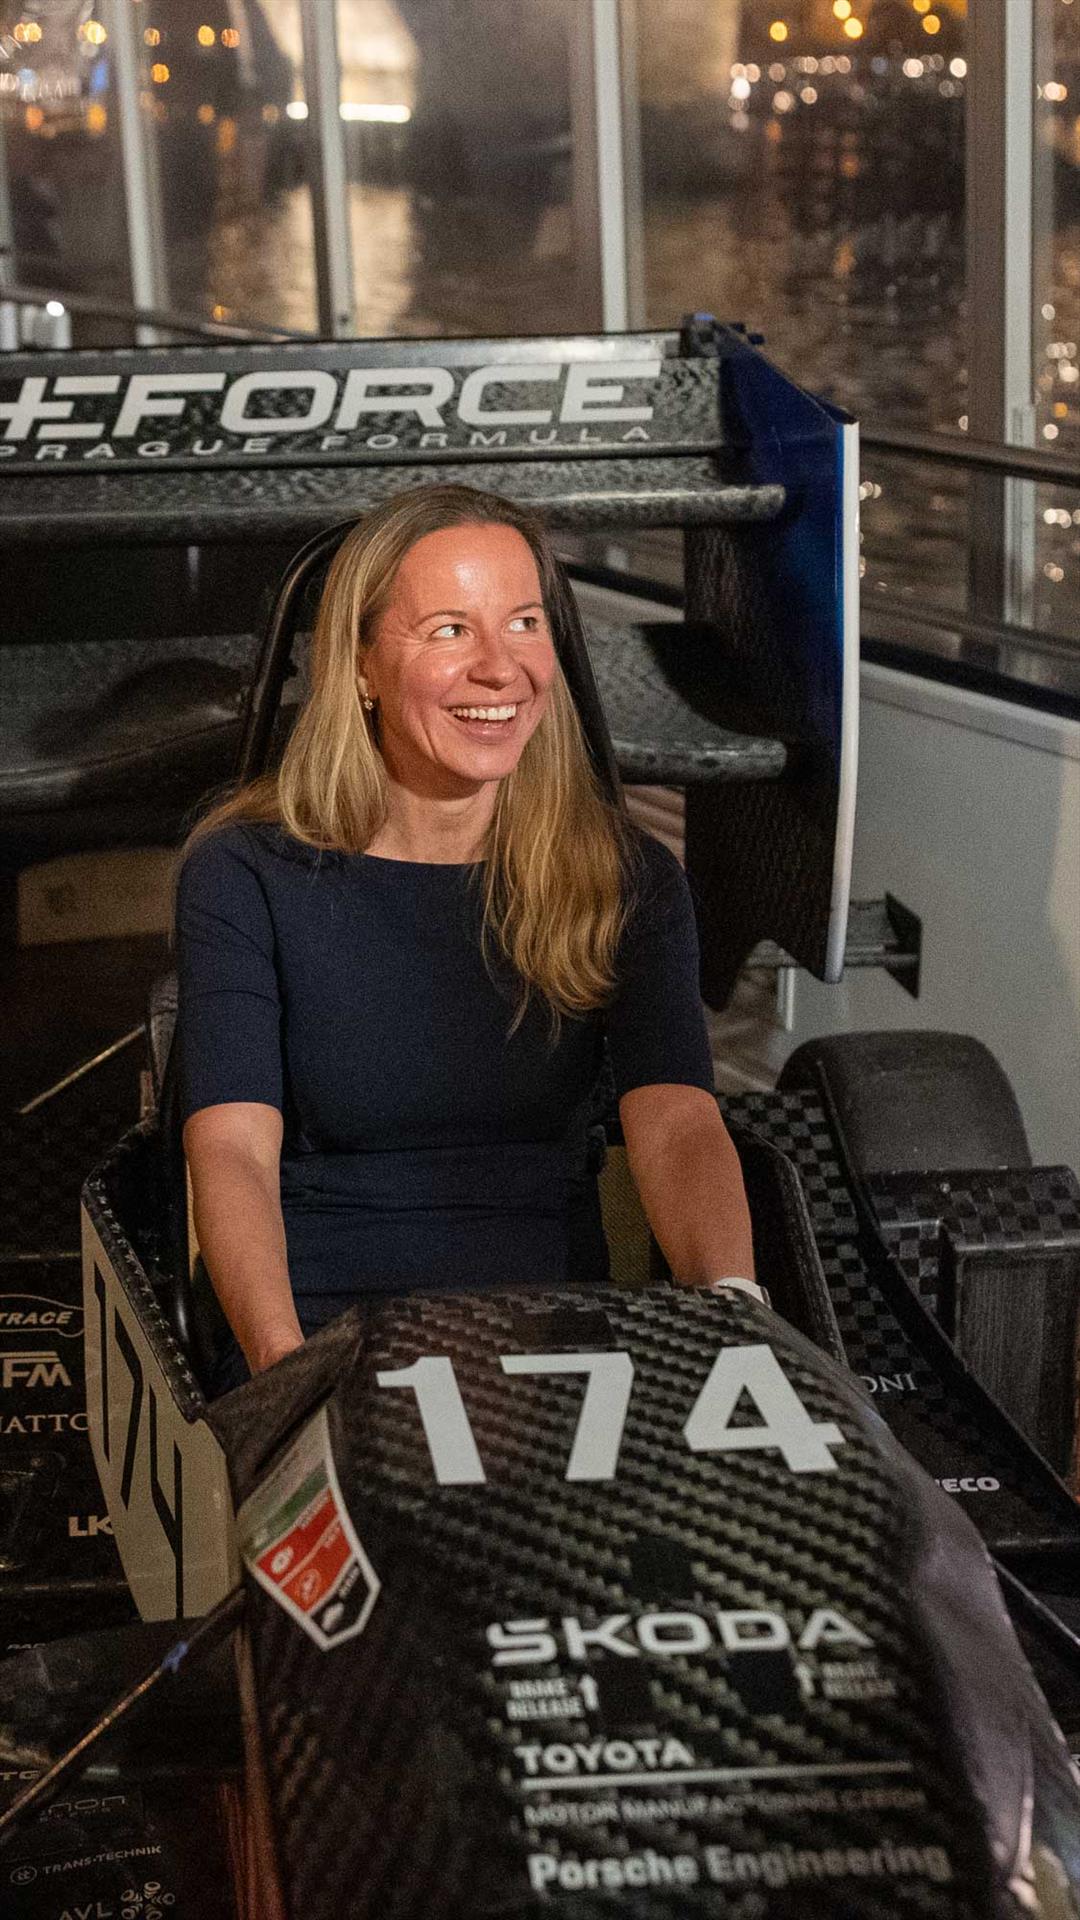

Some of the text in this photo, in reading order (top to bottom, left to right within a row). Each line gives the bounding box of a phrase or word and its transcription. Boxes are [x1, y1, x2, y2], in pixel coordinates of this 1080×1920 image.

[321, 426, 650, 451] FORMULA
[0, 1412, 89, 1434] ATTO
[376, 1344, 846, 1486] 174
[935, 1476, 1000, 1493] ECO
[514, 1738, 696, 1775] TOYOTA
[523, 1799, 618, 1827] MOTOR
[527, 1841, 953, 1891] Porsche Engineering
[58, 1901, 114, 1920] AVL
